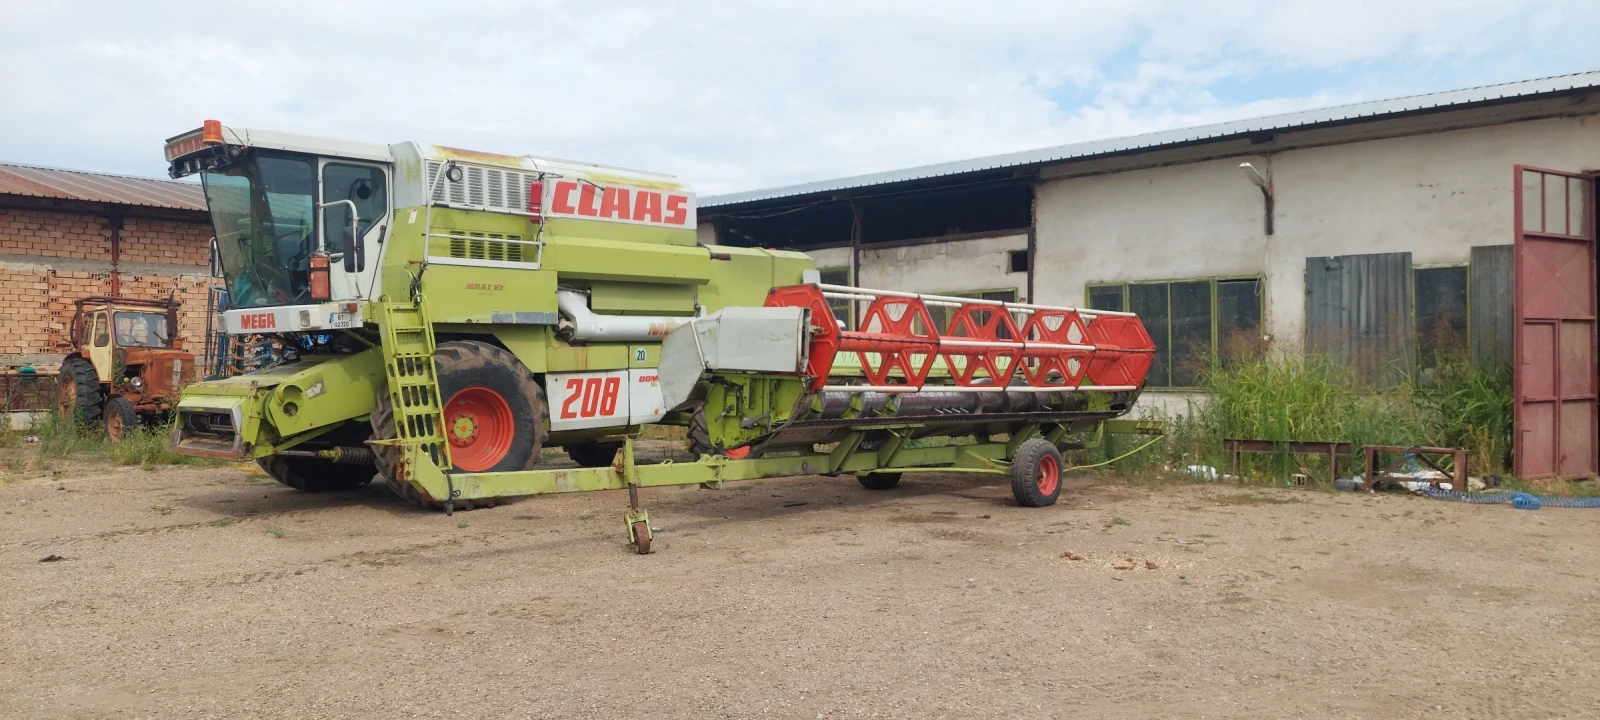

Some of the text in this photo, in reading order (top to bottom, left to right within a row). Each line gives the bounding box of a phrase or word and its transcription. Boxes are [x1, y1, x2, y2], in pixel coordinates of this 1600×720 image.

[169, 135, 207, 158] CLAA
[552, 181, 687, 225] CLAAS
[240, 313, 276, 329] MEGA
[636, 350, 646, 361] 20
[639, 375, 660, 383] DOM
[560, 377, 621, 419] 208
